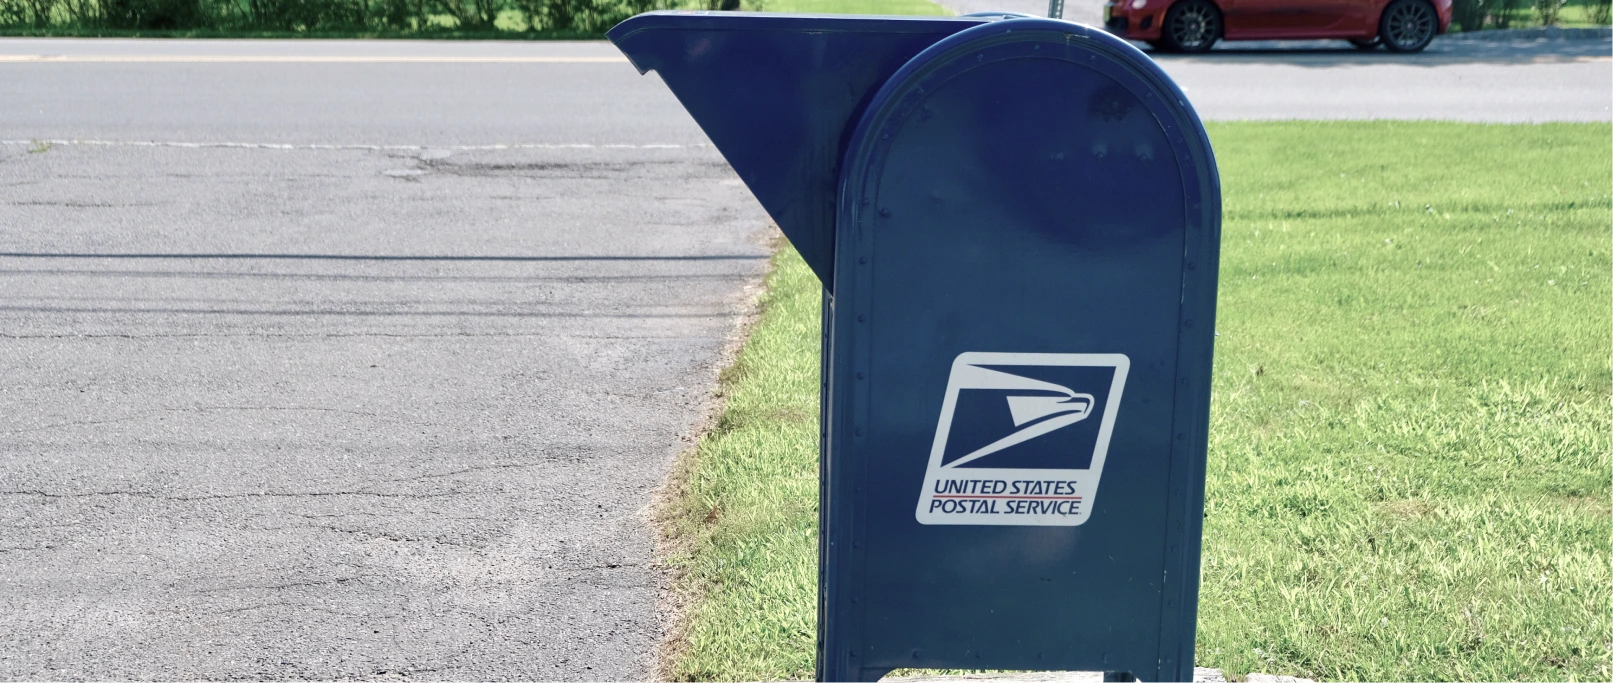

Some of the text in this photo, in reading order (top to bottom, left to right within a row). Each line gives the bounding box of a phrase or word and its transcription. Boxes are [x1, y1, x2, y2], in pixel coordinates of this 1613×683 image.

[934, 479, 1077, 495] UNITED STATES
[929, 499, 1000, 514] POSTAL
